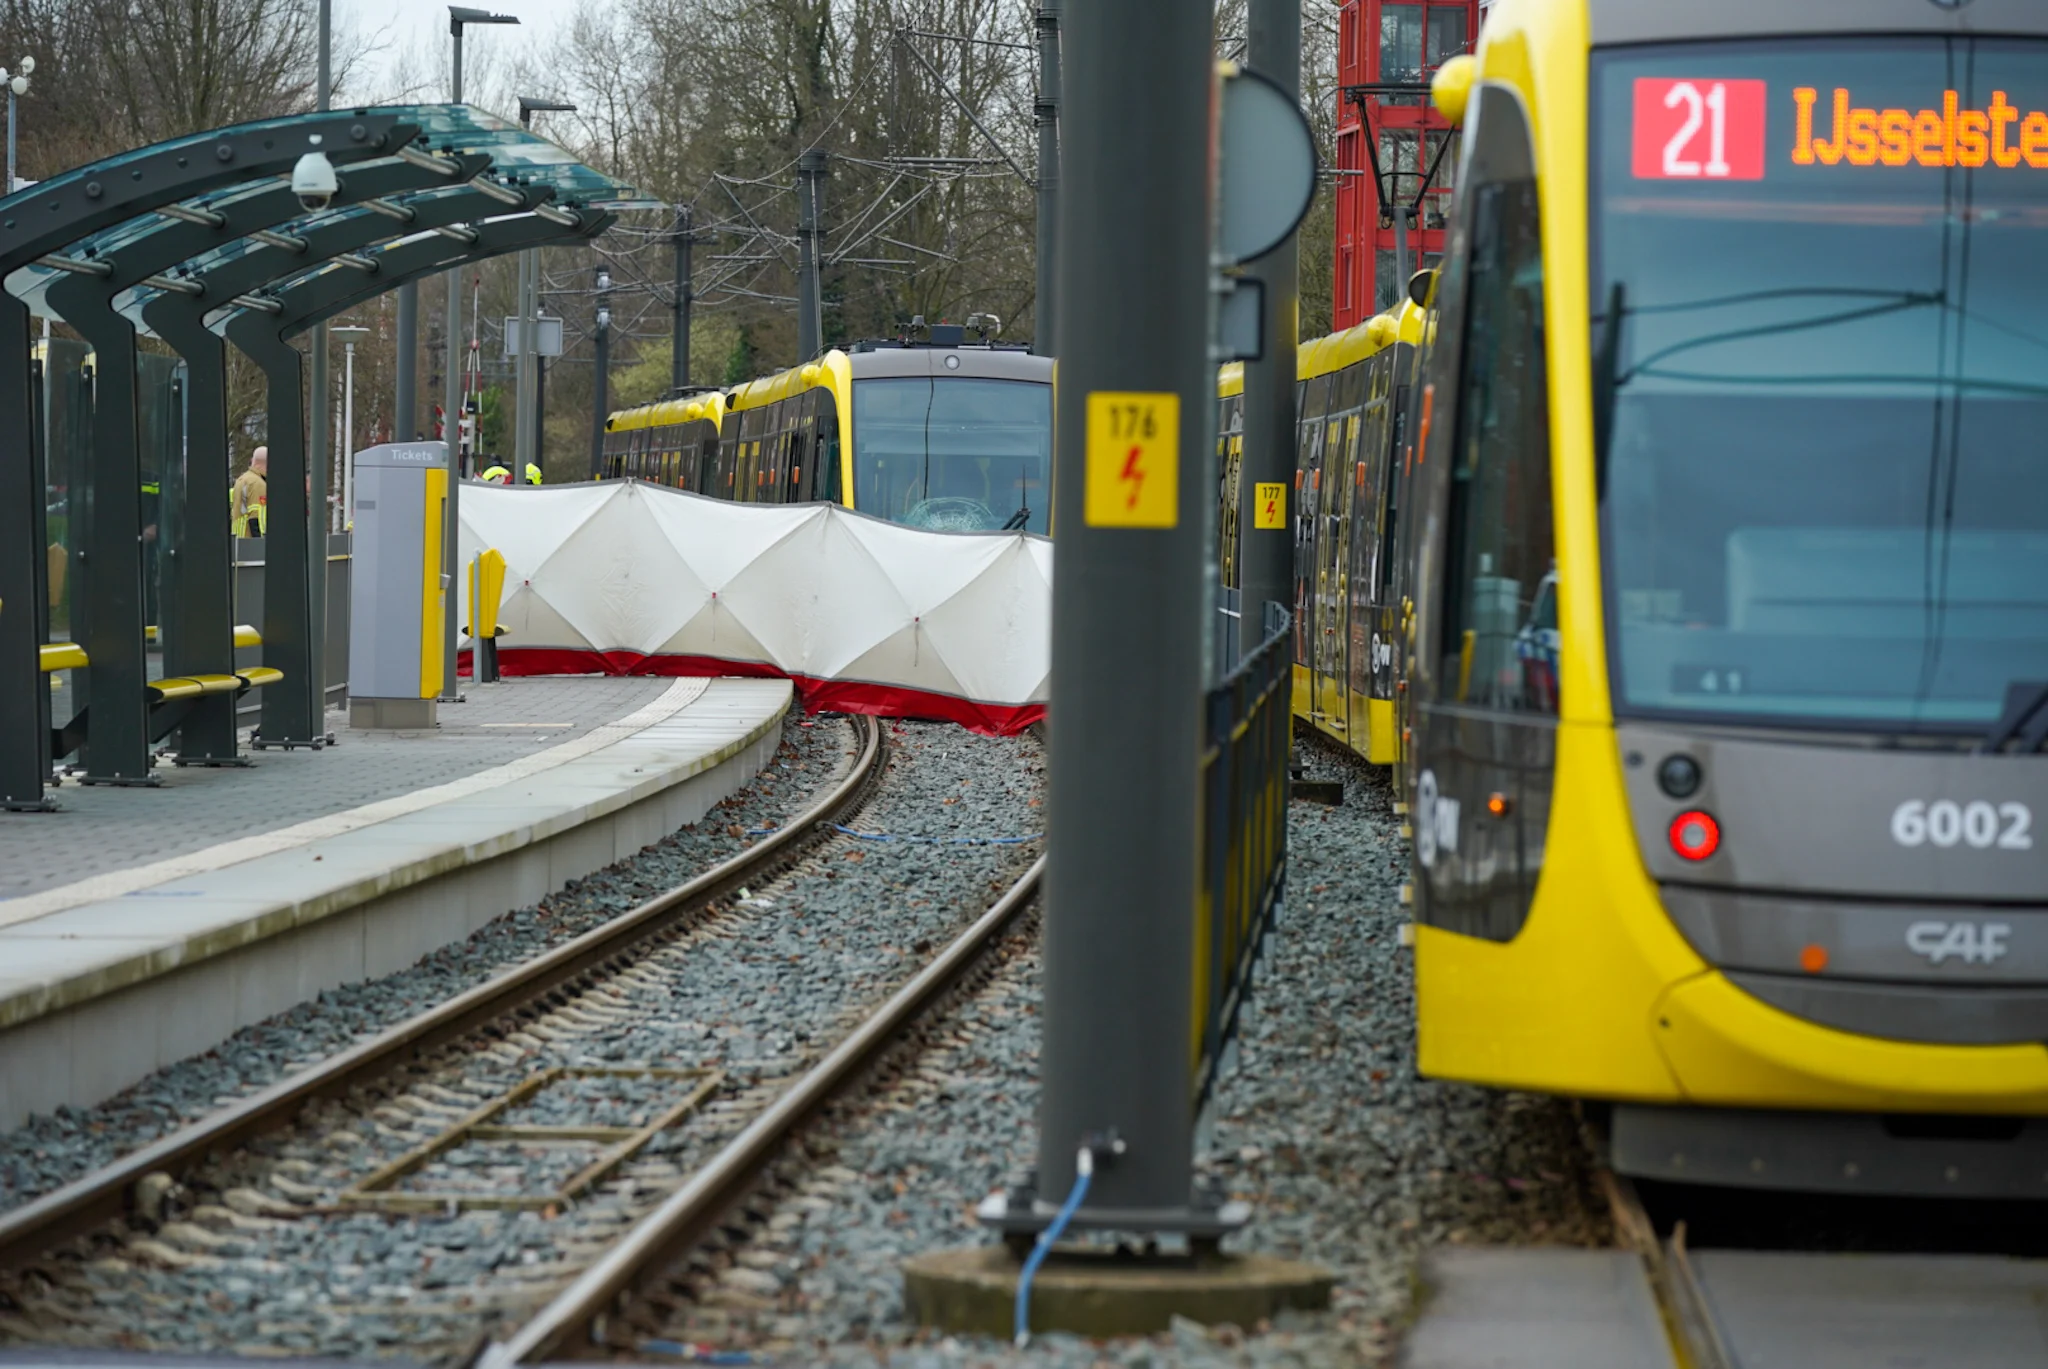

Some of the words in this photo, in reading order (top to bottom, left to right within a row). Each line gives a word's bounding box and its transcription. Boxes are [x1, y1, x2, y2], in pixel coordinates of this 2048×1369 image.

[1662, 81, 1730, 177] 21
[1791, 86, 2048, 168] IJsselste
[1108, 404, 1159, 440] 176
[391, 449, 433, 461] Tickets
[1263, 486, 1281, 499] 177
[1890, 799, 2034, 850] 6002
[1905, 920, 2013, 964] CAF
